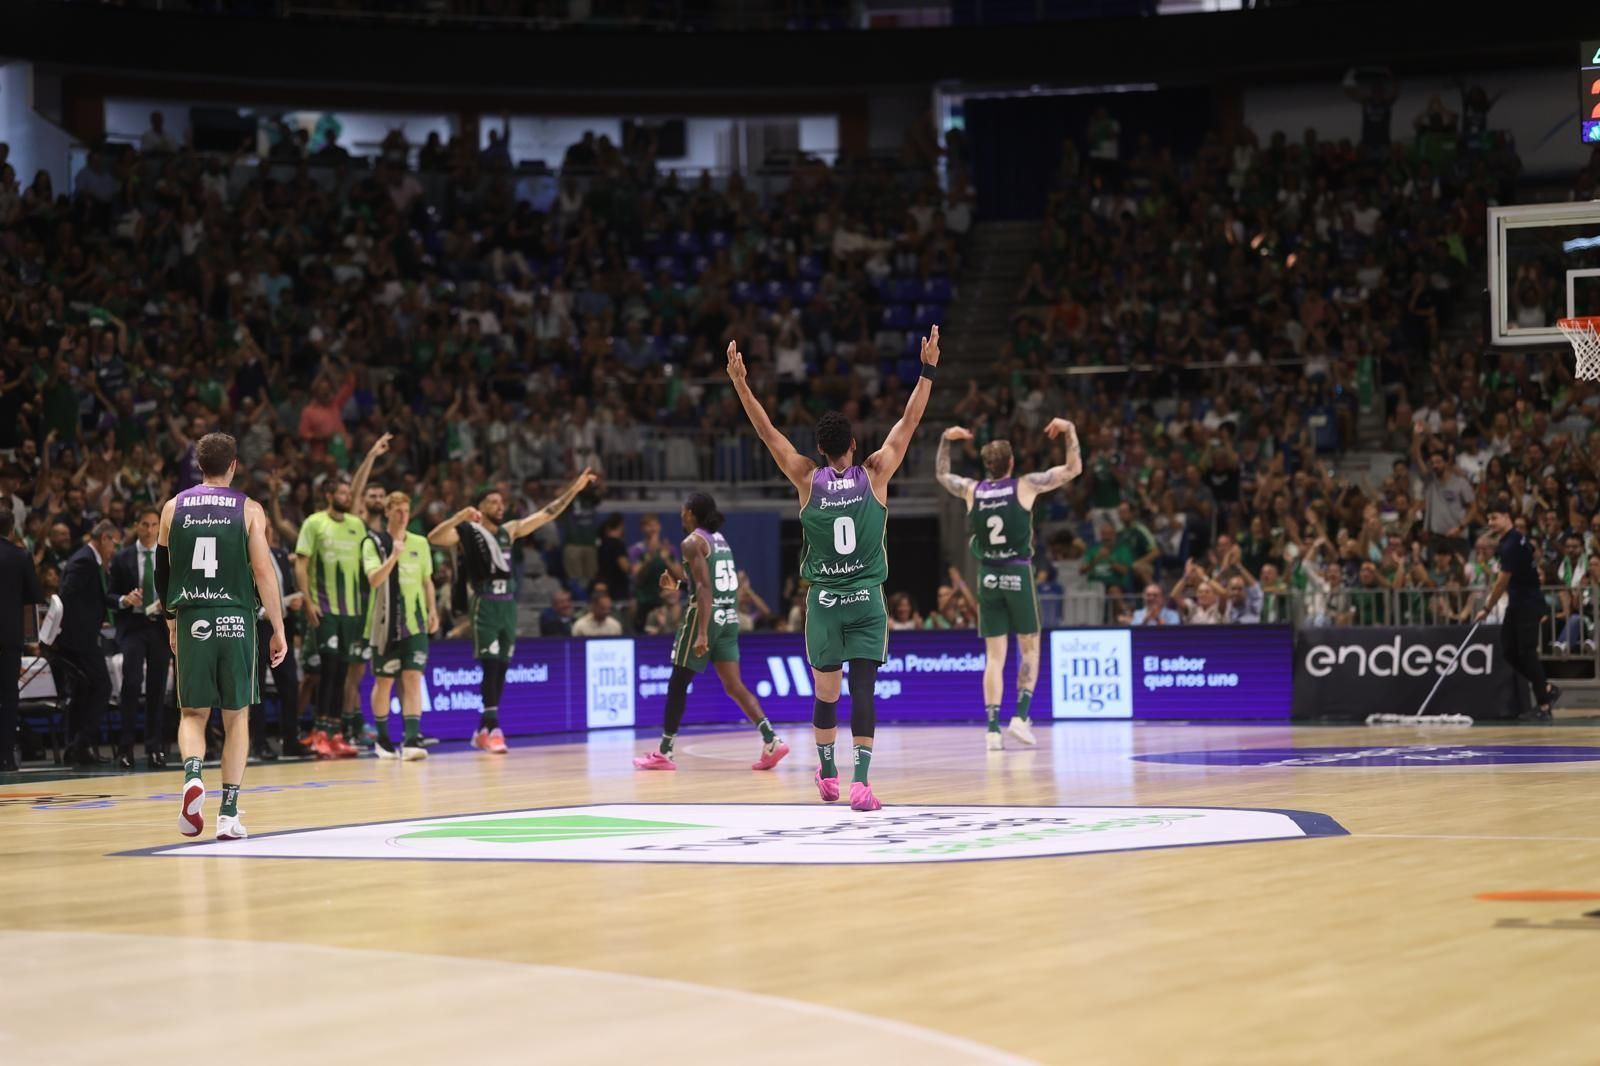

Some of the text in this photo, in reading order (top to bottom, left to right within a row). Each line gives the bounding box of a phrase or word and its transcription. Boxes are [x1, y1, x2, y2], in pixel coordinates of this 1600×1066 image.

[827, 478, 855, 491] TYSON
[183, 494, 237, 508] KALINOSKI
[833, 516, 857, 555] 0
[986, 515, 1007, 545] 2
[191, 537, 218, 578] 4
[819, 559, 865, 575] Andalucía
[715, 559, 738, 592] 55
[178, 586, 233, 600] Andalucía
[216, 616, 245, 624] COSTA
[905, 653, 986, 672] Provincial
[1072, 646, 1121, 677] má
[1144, 656, 1206, 672] El sabor
[1305, 635, 1493, 677] endesa
[1144, 673, 1239, 691] que nos une
[1062, 674, 1120, 713] laga
